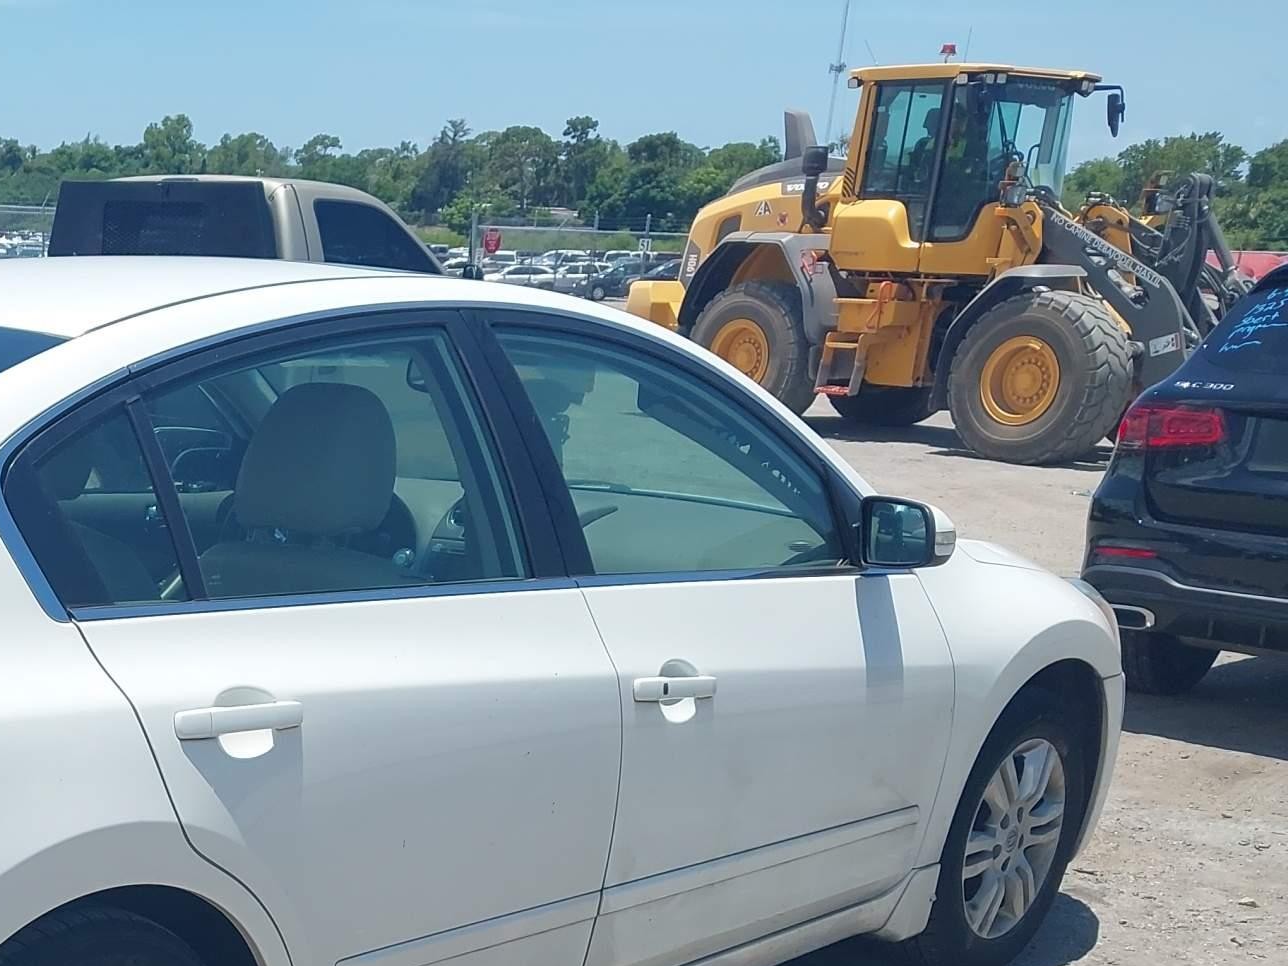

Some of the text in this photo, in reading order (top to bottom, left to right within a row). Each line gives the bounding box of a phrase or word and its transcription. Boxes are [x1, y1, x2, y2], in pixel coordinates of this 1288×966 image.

[1051, 211, 1064, 225] NO
[1064, 222, 1092, 243] CAMINE
[640, 240, 649, 252] 51
